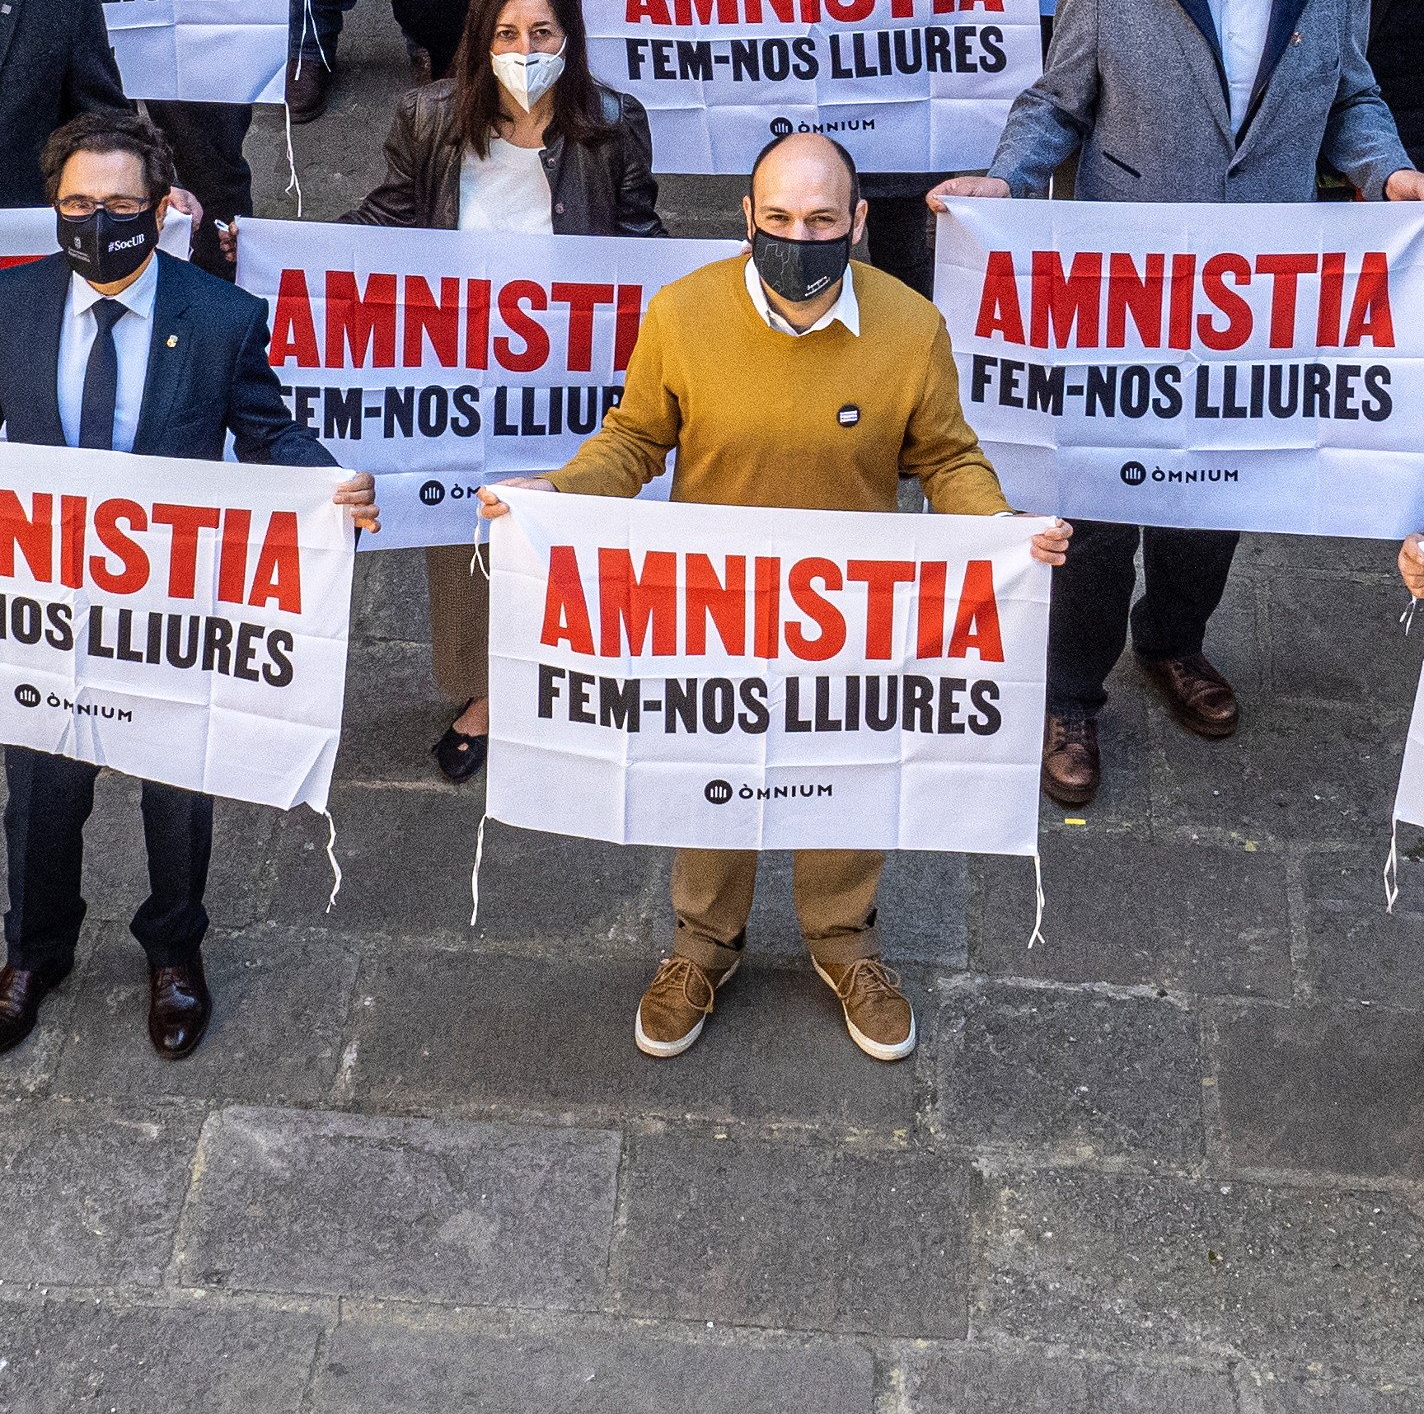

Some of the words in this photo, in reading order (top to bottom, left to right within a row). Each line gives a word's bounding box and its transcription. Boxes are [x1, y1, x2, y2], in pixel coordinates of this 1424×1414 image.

[626, 36, 818, 82] FEM-NOS
[829, 25, 1007, 79] LLIURES
[798, 119, 875, 135] ÒMNIUM
[268, 269, 643, 373] AMNISTI
[975, 251, 1395, 350] AMNISTIA
[971, 354, 1183, 419] FEM-NOS
[1195, 363, 1393, 422] LLIURES
[1151, 466, 1239, 483] ÒMNIUM
[539, 545, 1005, 662] AMNISTIA
[87, 604, 294, 687] LLIURES
[46, 690, 133, 723] ÒMNIUM
[537, 663, 770, 735] FEM-NOS
[784, 674, 1003, 736] LLIURES
[739, 783, 833, 800] ÒMNIUM
